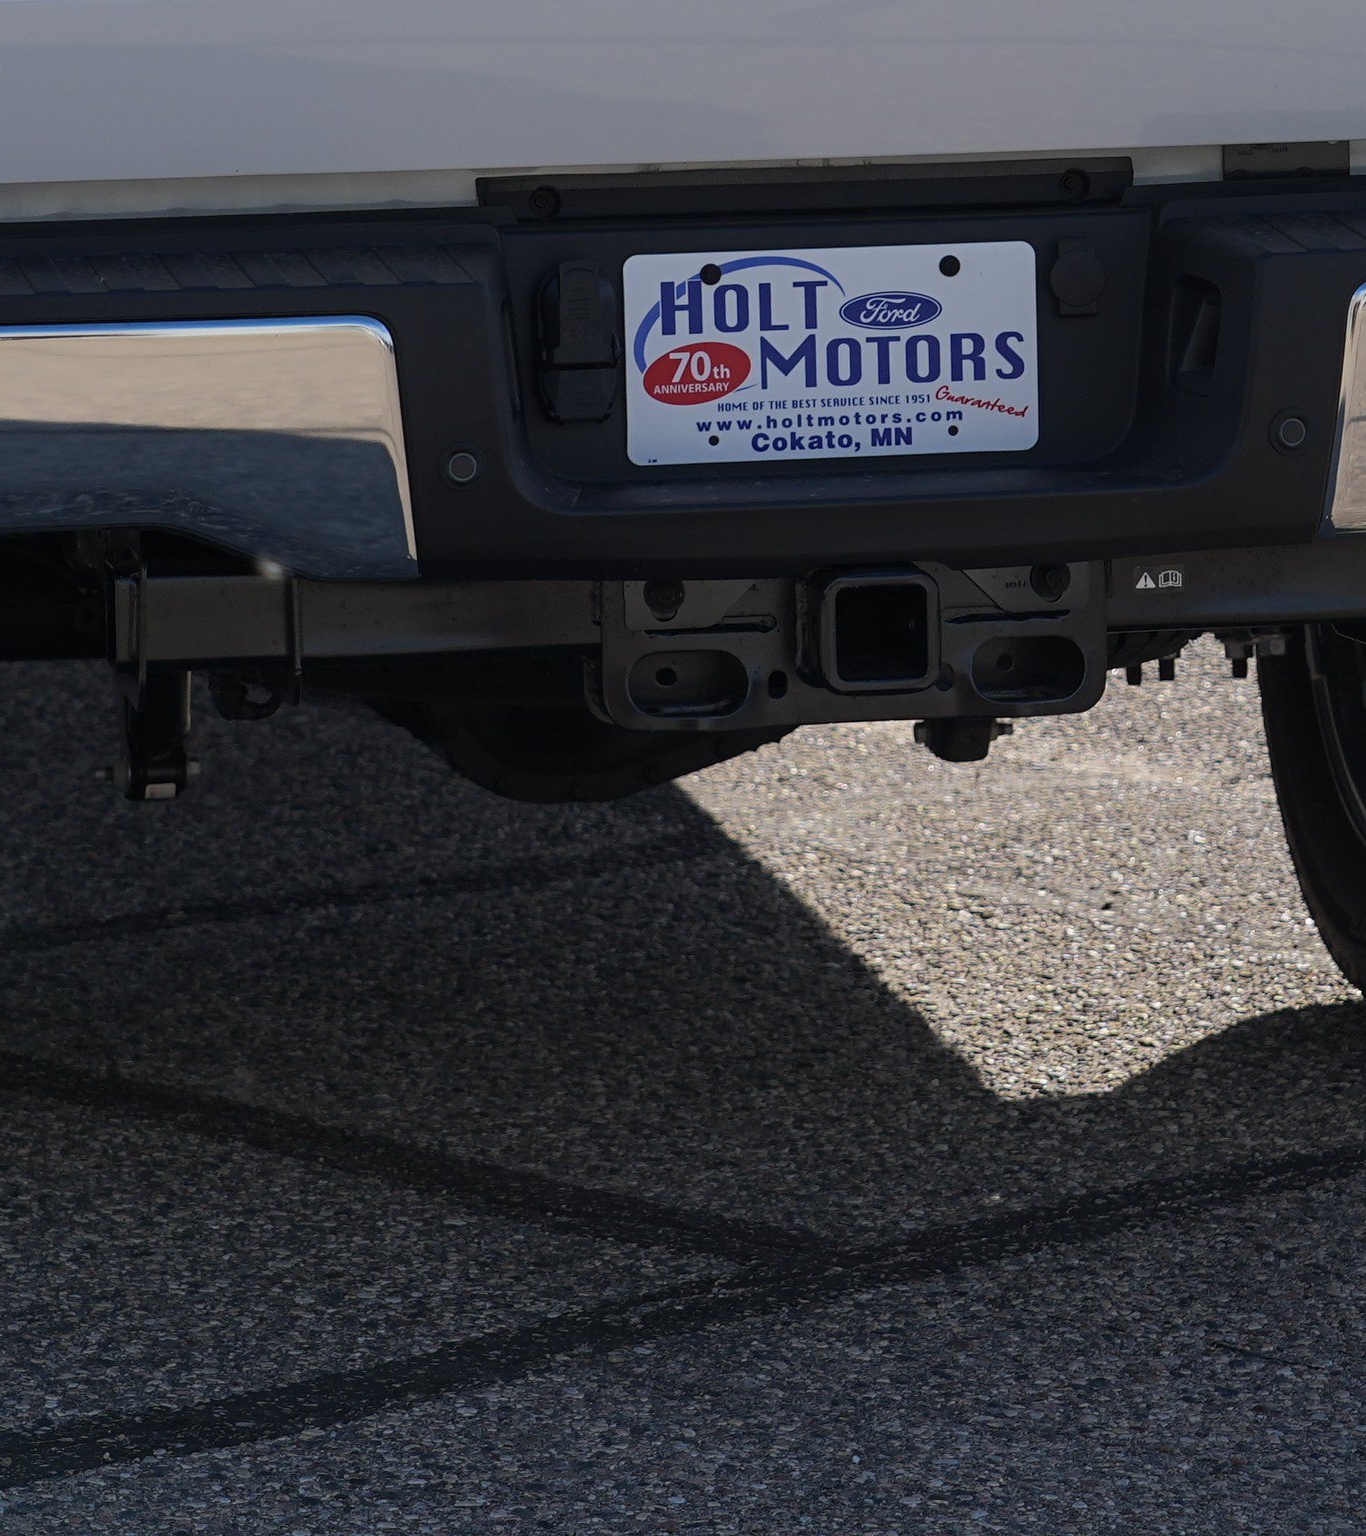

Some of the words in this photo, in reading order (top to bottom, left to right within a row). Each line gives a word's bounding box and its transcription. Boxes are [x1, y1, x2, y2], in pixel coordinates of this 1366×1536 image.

[660, 278, 828, 336] HOLT
[859, 296, 921, 324] Ford
[669, 350, 731, 383] 70th
[760, 331, 1025, 390] MOTORS
[653, 382, 731, 395] ANNIVERSARY
[935, 385, 1029, 418] Guaranteed
[717, 401, 748, 412] HOME
[752, 400, 765, 410] OF
[768, 399, 788, 410] THE
[792, 398, 817, 409] BEST
[821, 396, 865, 408] SERVICE
[869, 395, 901, 406] SINCE
[906, 394, 931, 404] 1951
[696, 409, 963, 432] www.holtmotors.com
[751, 431, 861, 452] Cokato,
[871, 427, 913, 447] MN
